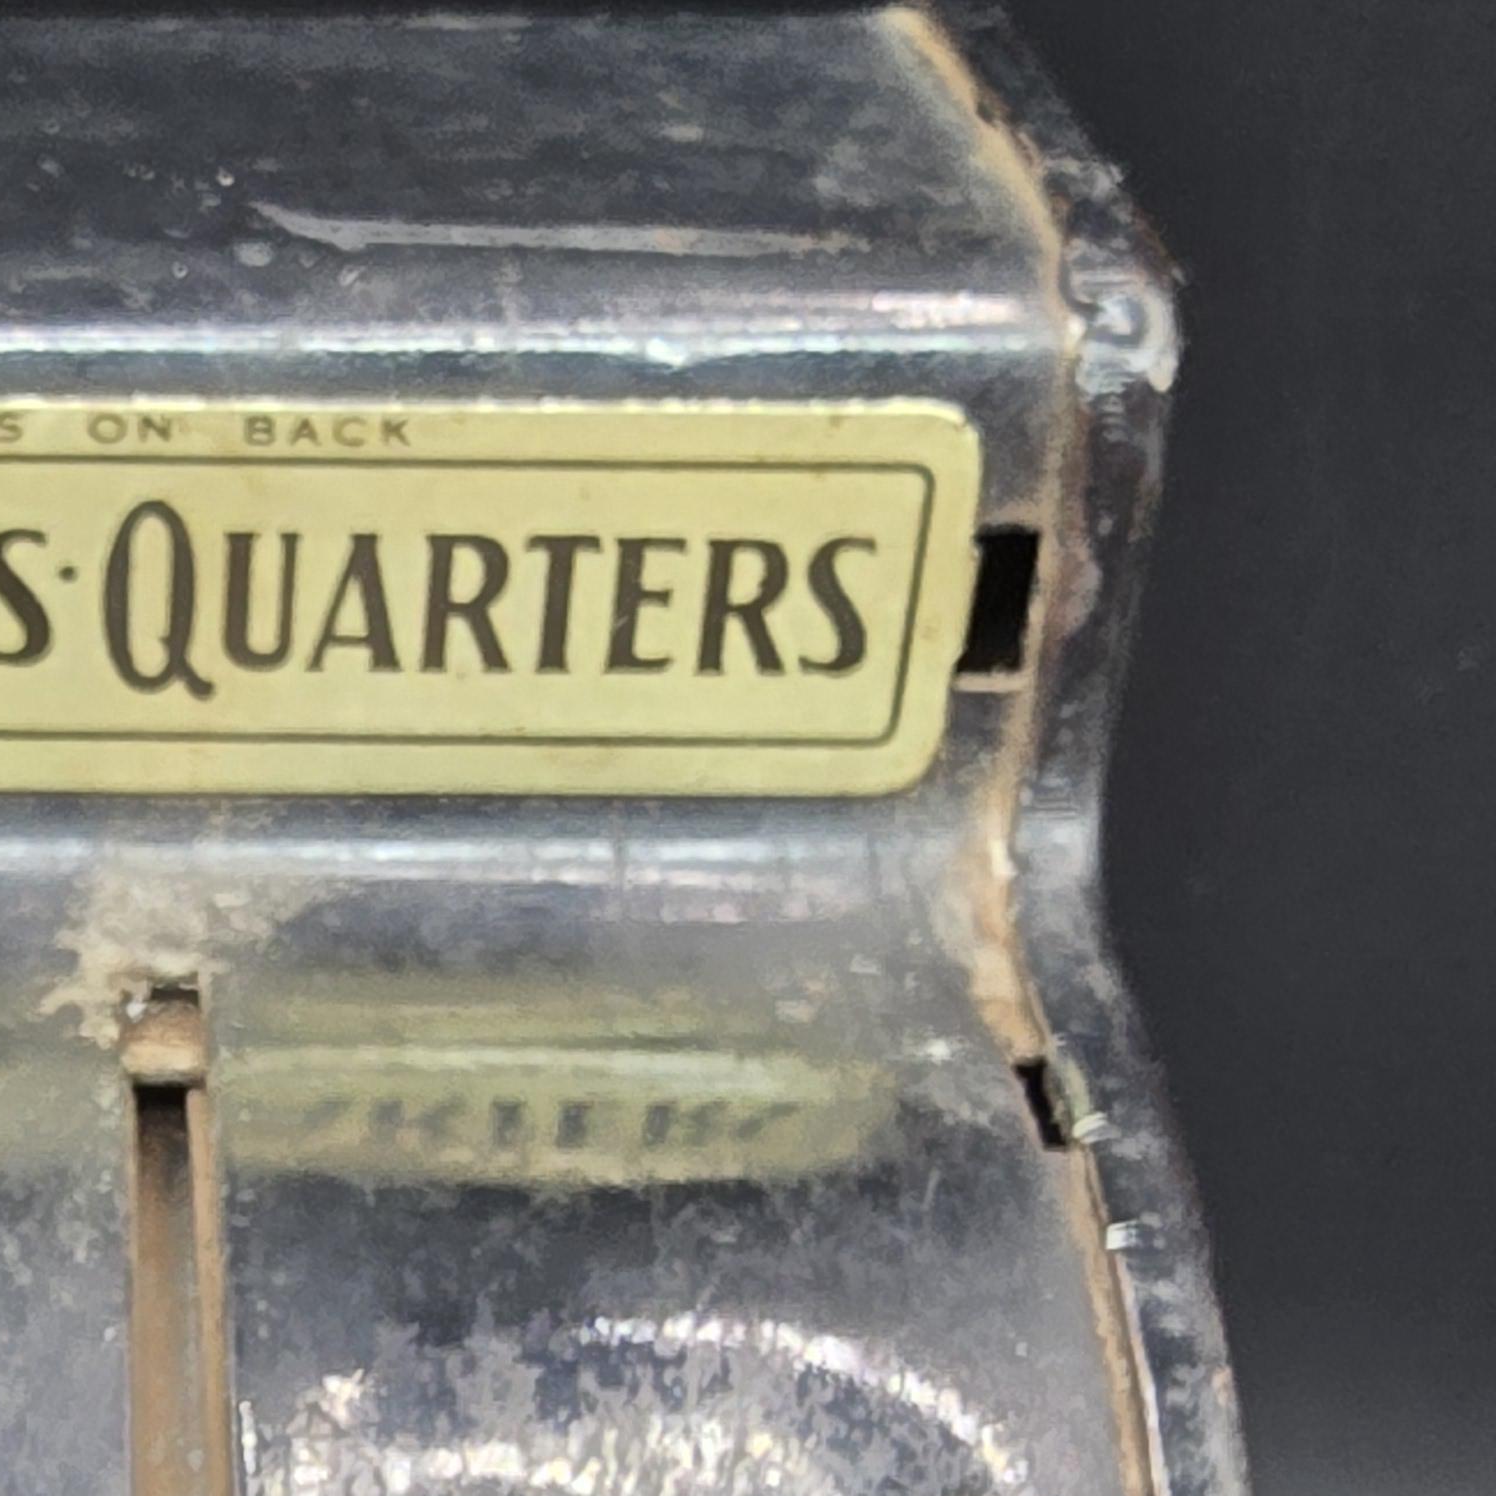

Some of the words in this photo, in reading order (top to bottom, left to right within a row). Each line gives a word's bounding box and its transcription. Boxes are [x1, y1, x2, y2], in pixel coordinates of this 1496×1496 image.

[87, 412, 172, 446] ON
[245, 414, 411, 448] BACK
[103, 499, 879, 702] QUARTERS
